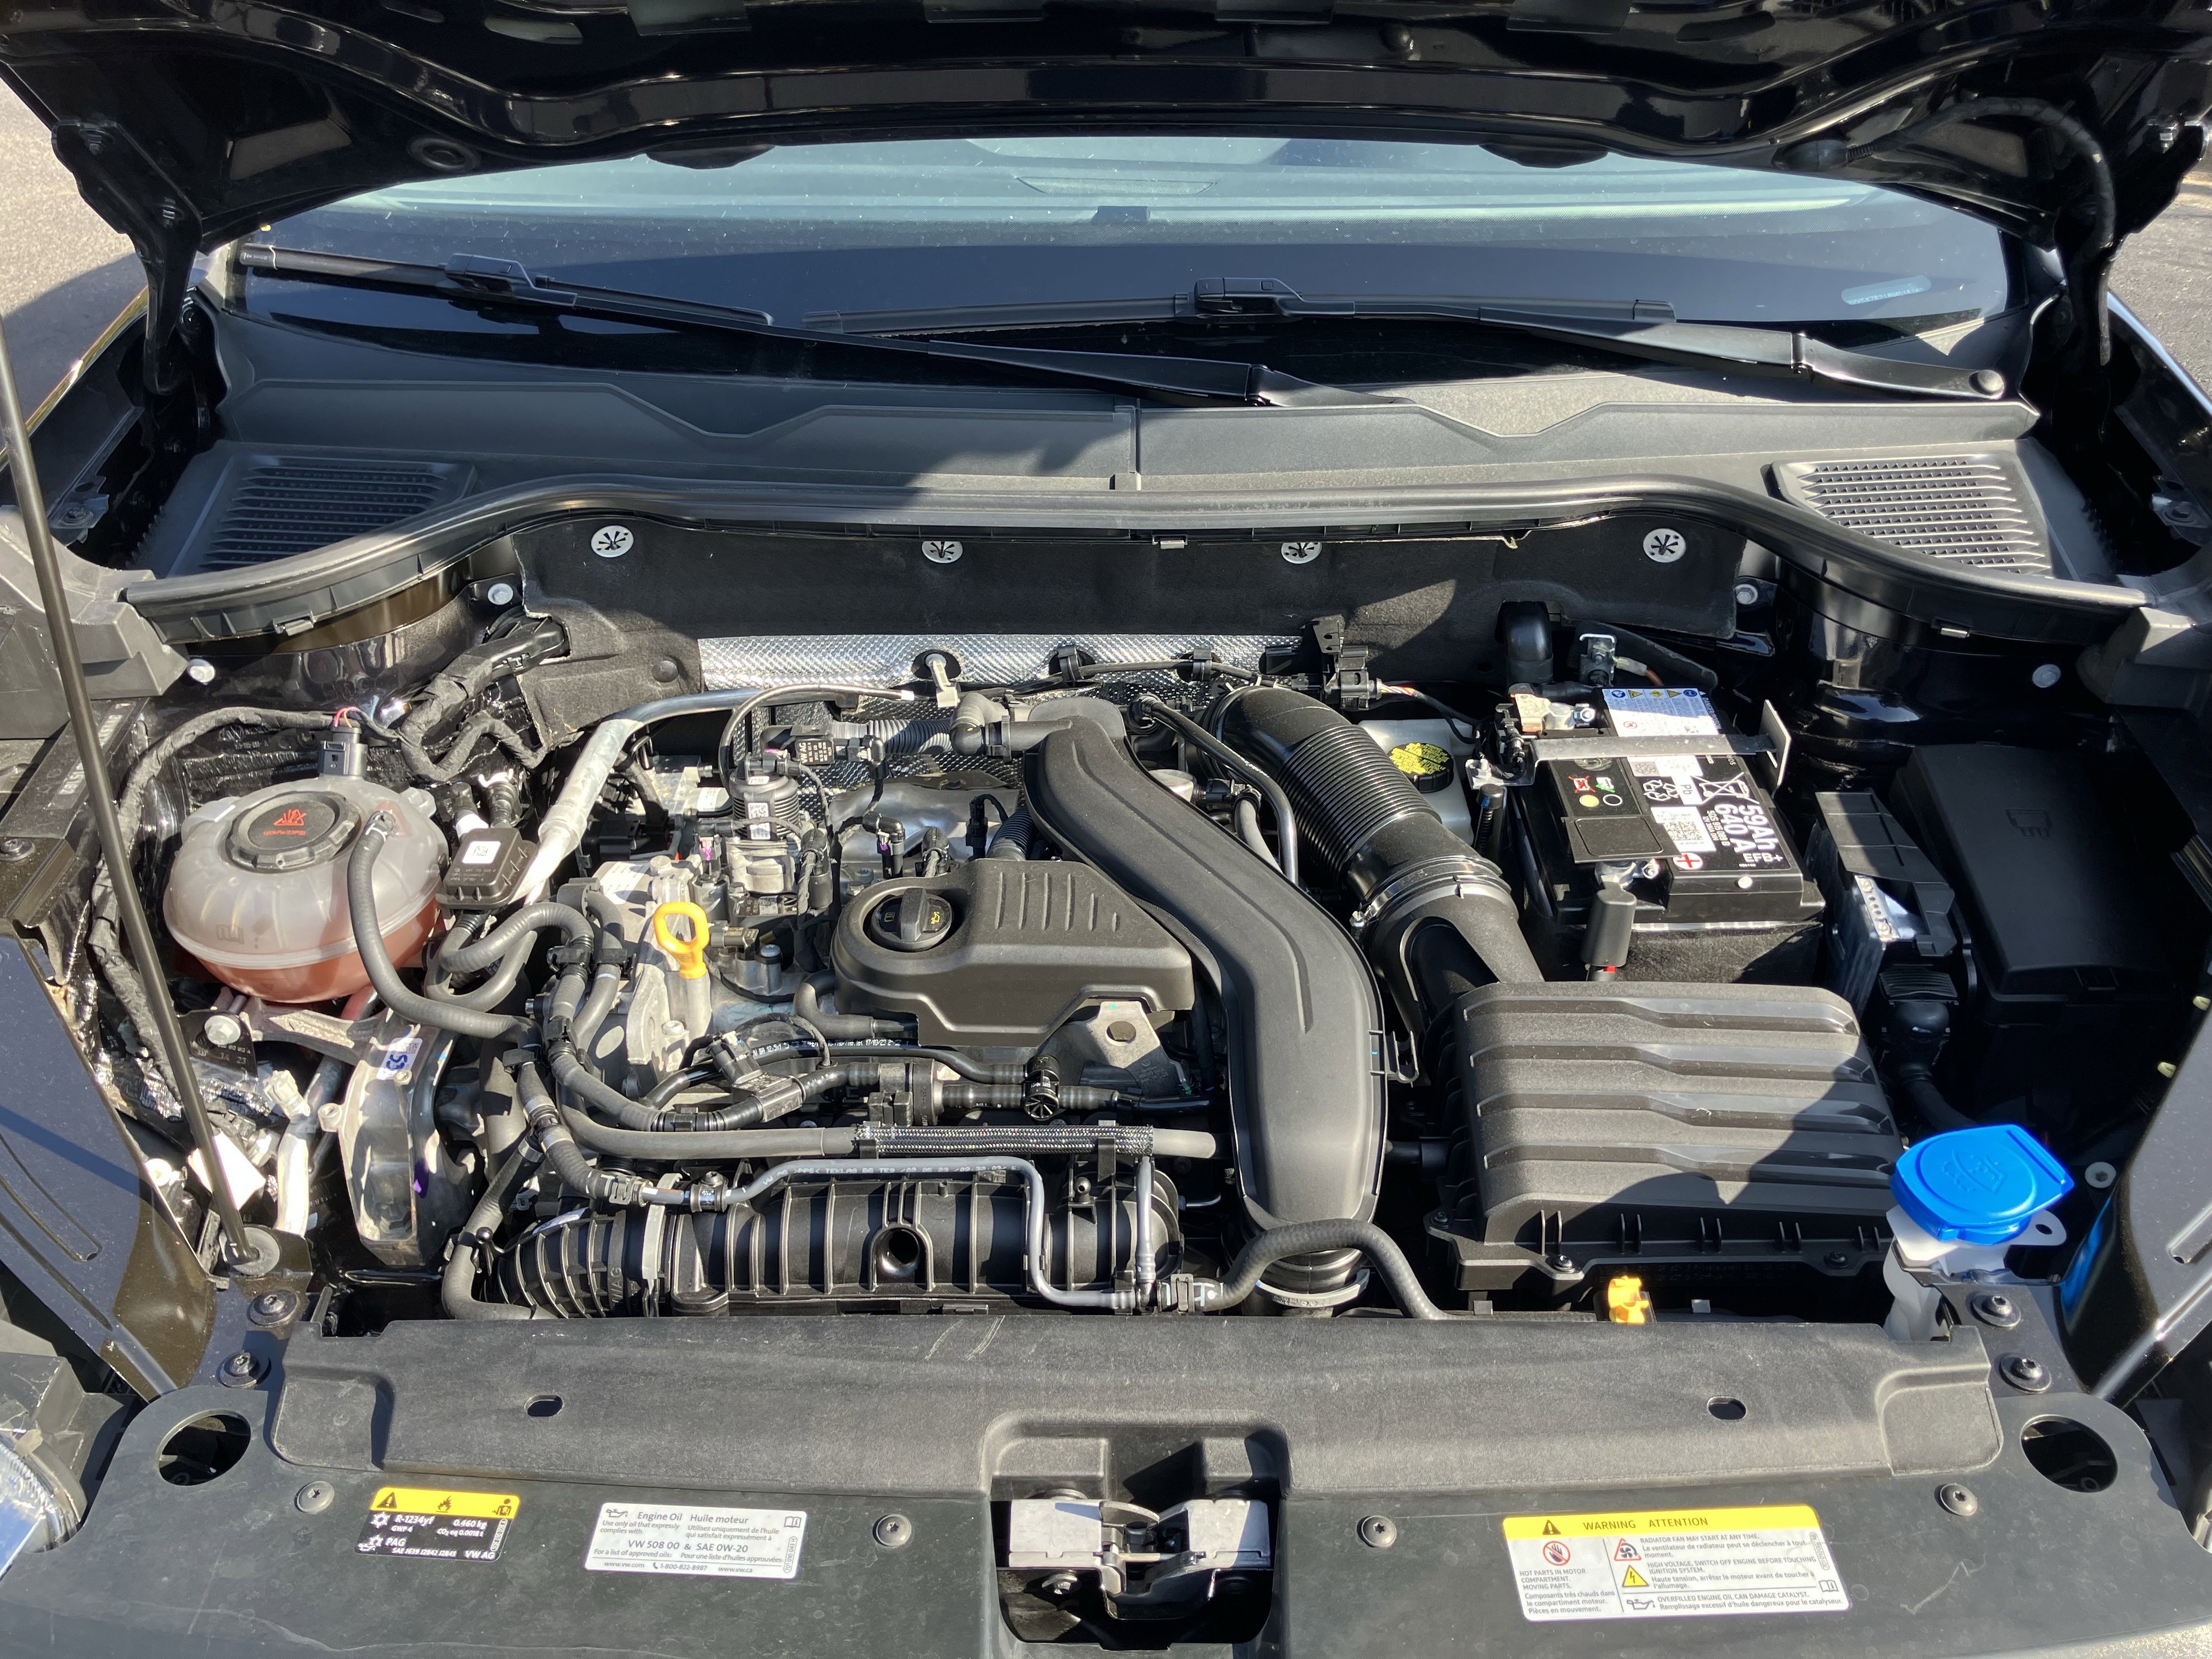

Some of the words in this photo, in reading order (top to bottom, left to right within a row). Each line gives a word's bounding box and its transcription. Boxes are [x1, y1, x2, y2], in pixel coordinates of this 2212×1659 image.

[799, 742, 807, 752] AG
[800, 753, 808, 764] VW
[1680, 784, 1694, 795] Pb
[1714, 804, 1749, 835] 640
[1738, 804, 1779, 850] 59Ah
[1729, 838, 1757, 853] A
[1742, 852, 1784, 862] EFB+
[394, 1514, 435, 1525] R-1234yf
[637, 1512, 668, 1522] Engine
[690, 1514, 713, 1522] Huile
[715, 1516, 749, 1524] moteur
[1649, 1517, 1708, 1528] ATTENTION
[453, 1519, 476, 1527] 0.460
[477, 1521, 488, 1530] kg
[1583, 1520, 1636, 1531] WARNING
[385, 1538, 407, 1547] PAG
[647, 1541, 665, 1549] 508
[667, 1541, 680, 1549] 00
[696, 1543, 714, 1551] SAE
[716, 1544, 748, 1553] 0W-20
[464, 1550, 481, 1559] VW
[481, 1551, 496, 1560] AG
[1534, 1599, 1581, 1607] compartiment
